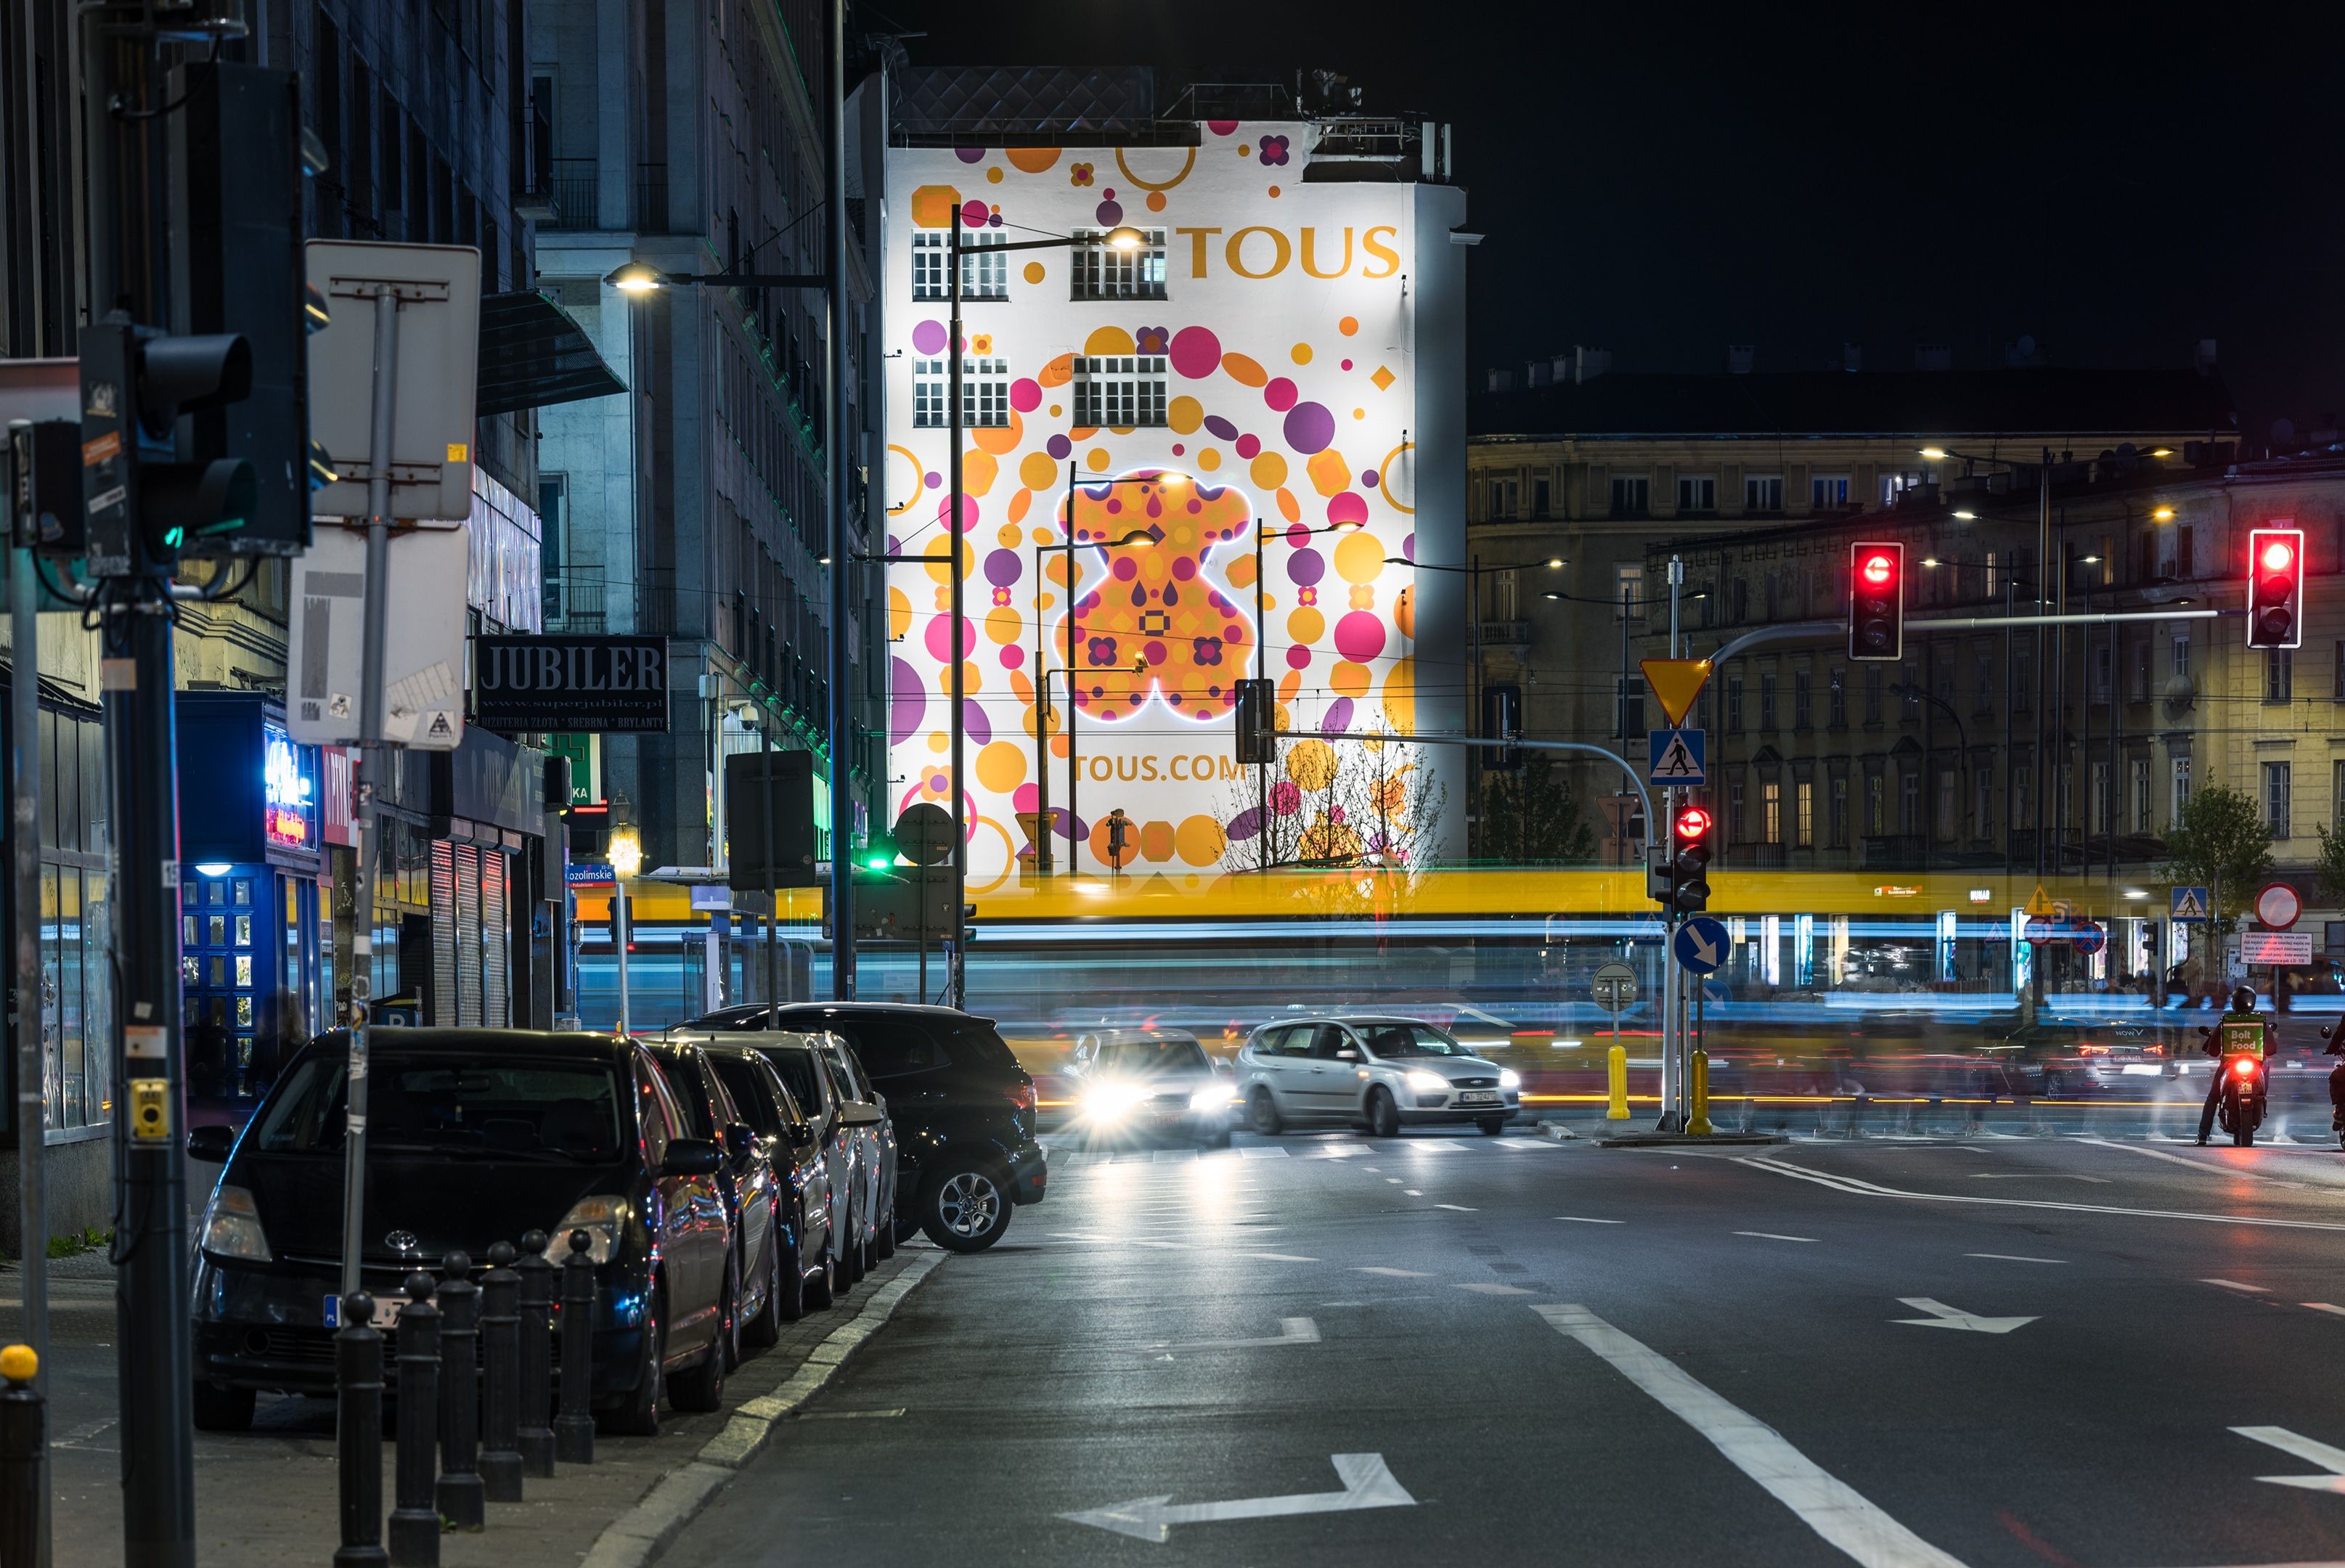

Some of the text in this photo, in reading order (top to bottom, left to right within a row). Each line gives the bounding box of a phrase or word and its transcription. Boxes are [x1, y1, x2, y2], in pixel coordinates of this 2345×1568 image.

[1175, 226, 1400, 279] TOUS
[481, 646, 664, 690] JUBILER
[482, 699, 663, 709] www.superjubiler.pl
[530, 716, 558, 728] ZŁOTA
[568, 716, 608, 728] SREBRNA
[618, 716, 664, 728] BRYLANTY
[1074, 754, 1246, 781] TOUS.COM
[569, 869, 612, 881] ozolimskie
[2231, 1030, 2251, 1040] Bolt
[2231, 1041, 2256, 1050] Food
